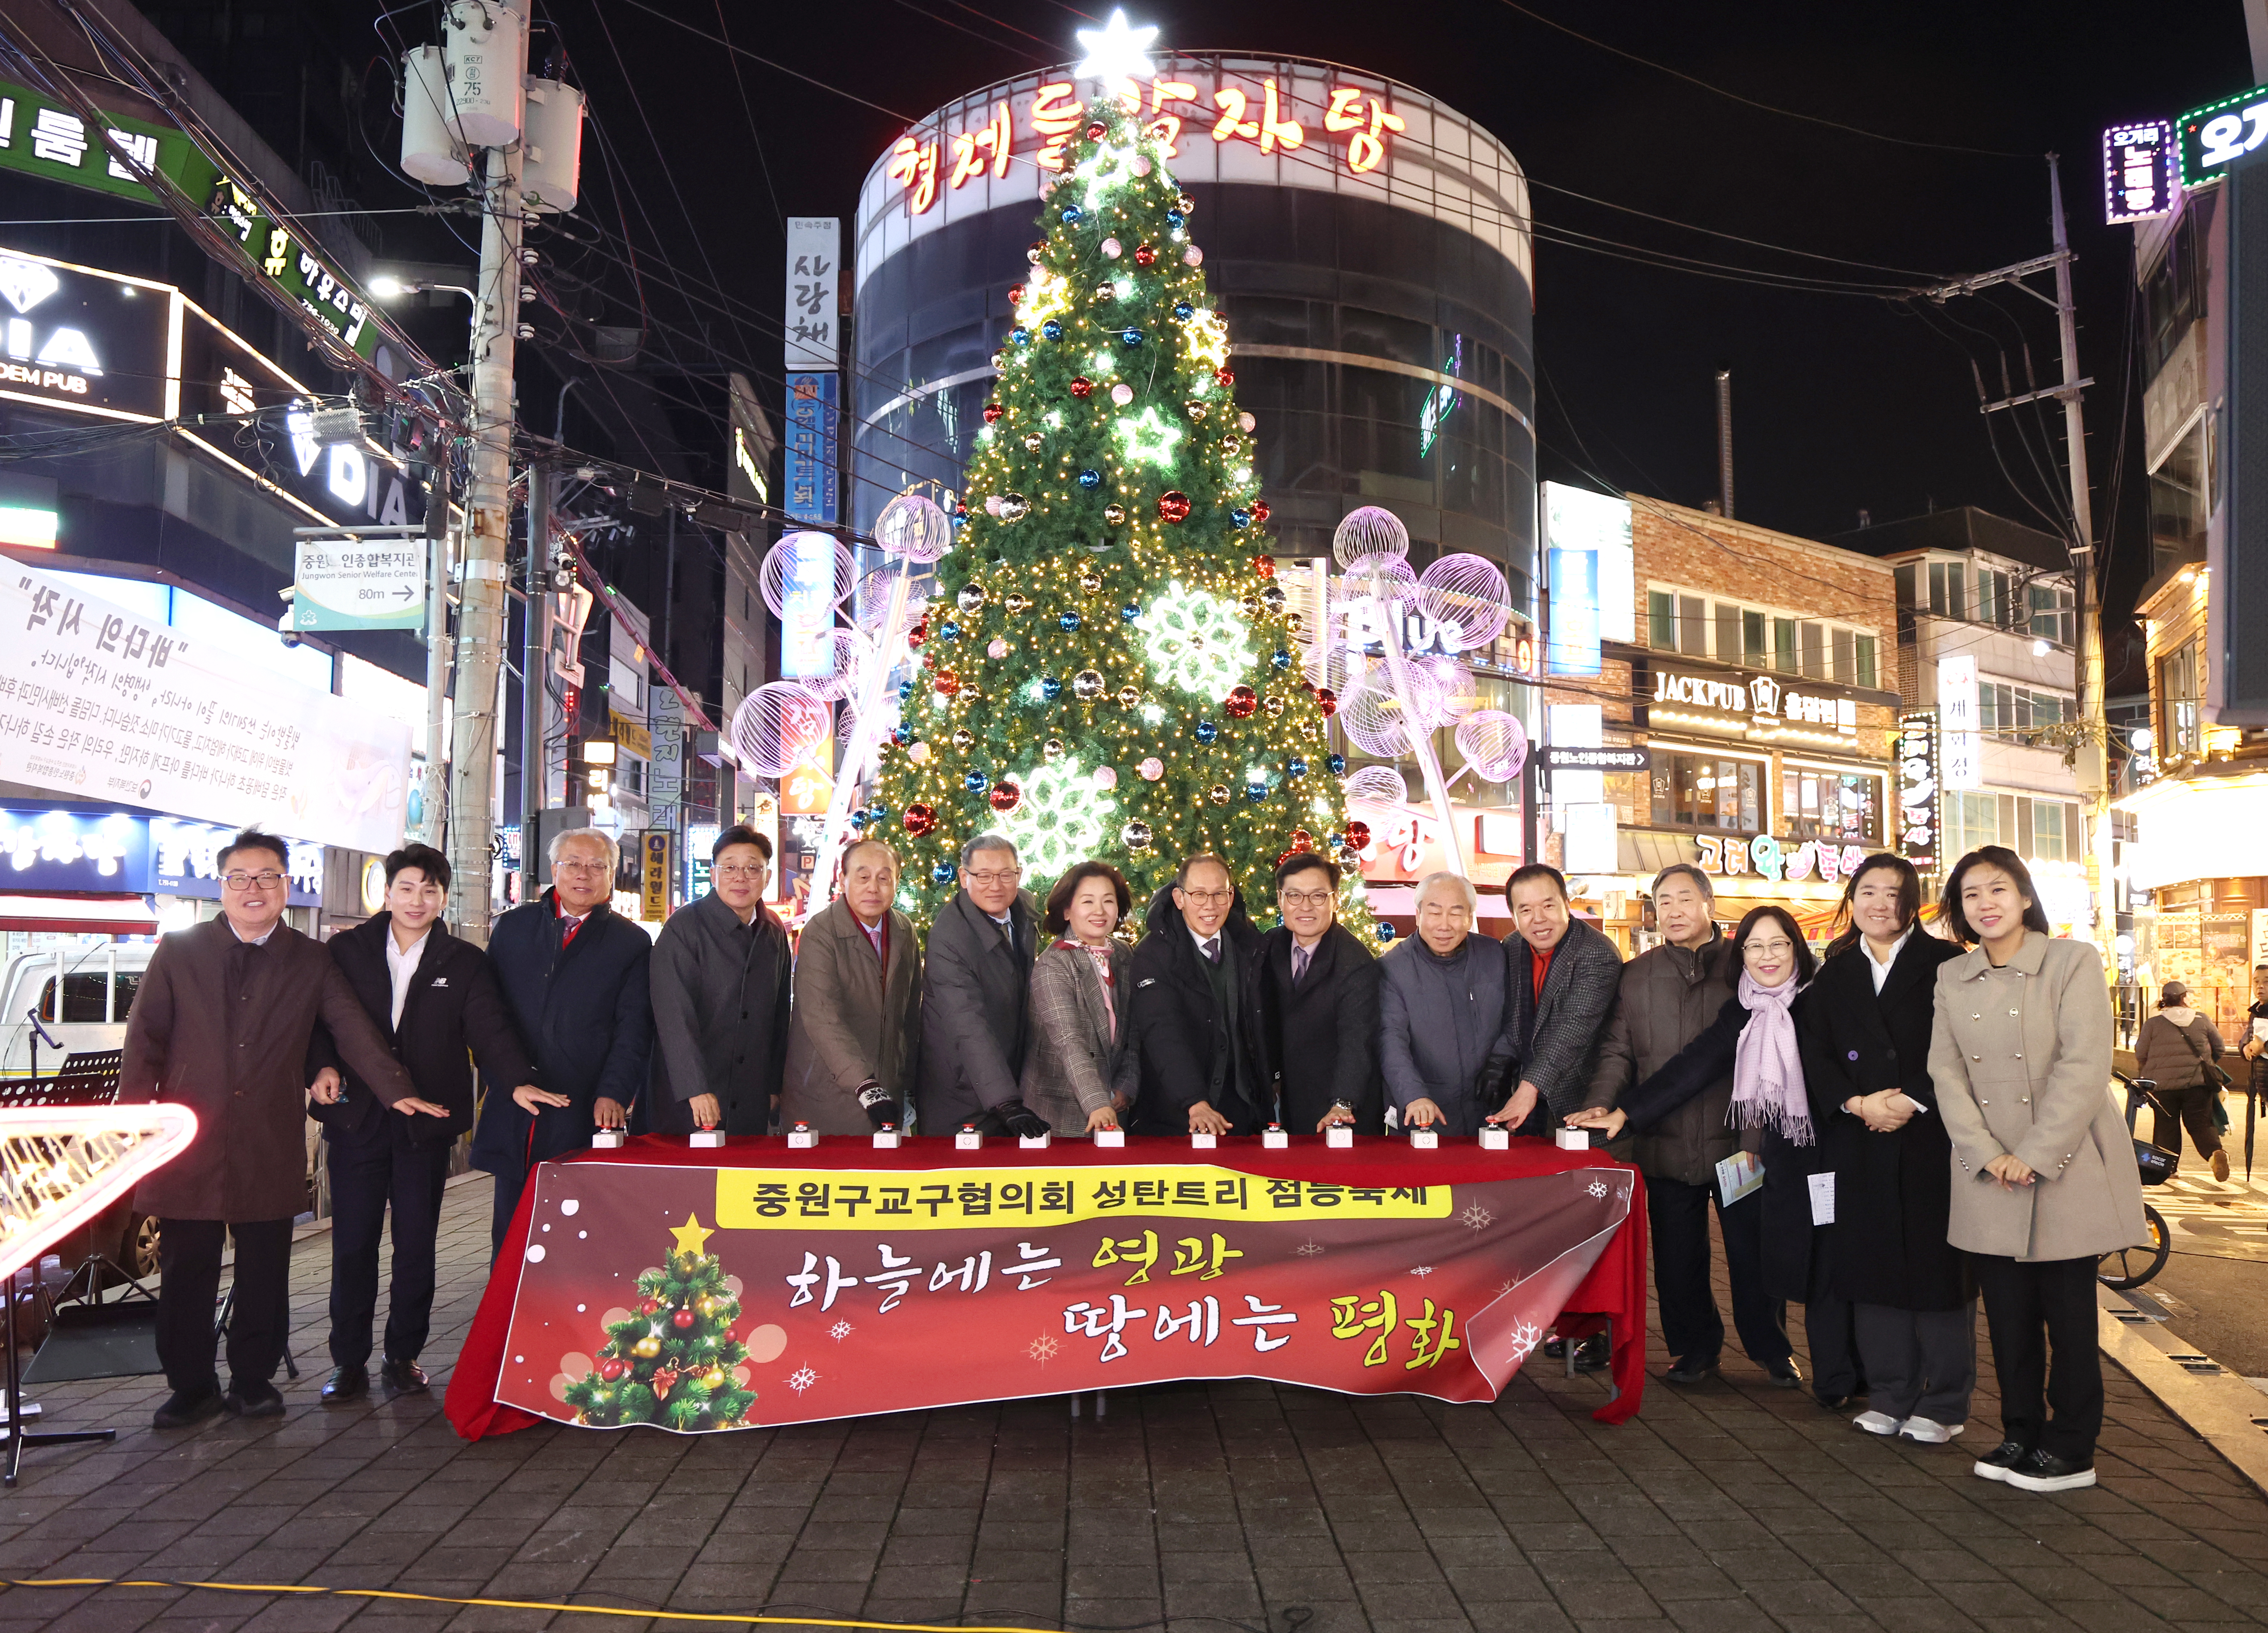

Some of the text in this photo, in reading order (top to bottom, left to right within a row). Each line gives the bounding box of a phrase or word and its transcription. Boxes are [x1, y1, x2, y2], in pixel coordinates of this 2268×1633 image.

[464, 82, 481, 96] 75
[2124, 146, 2155, 210] 노래방
[795, 221, 831, 230] 민속주점
[265, 227, 289, 276] 휴
[302, 299, 339, 335] 736-1030
[794, 255, 831, 342] 사랑채
[0, 317, 104, 376] IA
[43, 371, 87, 394] PUB
[302, 572, 335, 580] Jungwon
[364, 570, 392, 578] Welfare
[303, 553, 415, 570] 중원인종합복지관
[359, 589, 384, 599] 80m
[1654, 671, 1747, 711] JACKPUB
[1549, 751, 1637, 766] 중원노인종합복지관
[1696, 834, 1786, 882] 고려왕
[753, 1180, 1075, 1218] 중원구교구협의회
[1092, 1178, 1247, 1211] 성탄트리
[786, 1229, 1244, 1314] 하늘에는 영광
[1063, 1290, 1461, 1371] 땅에는 평화
